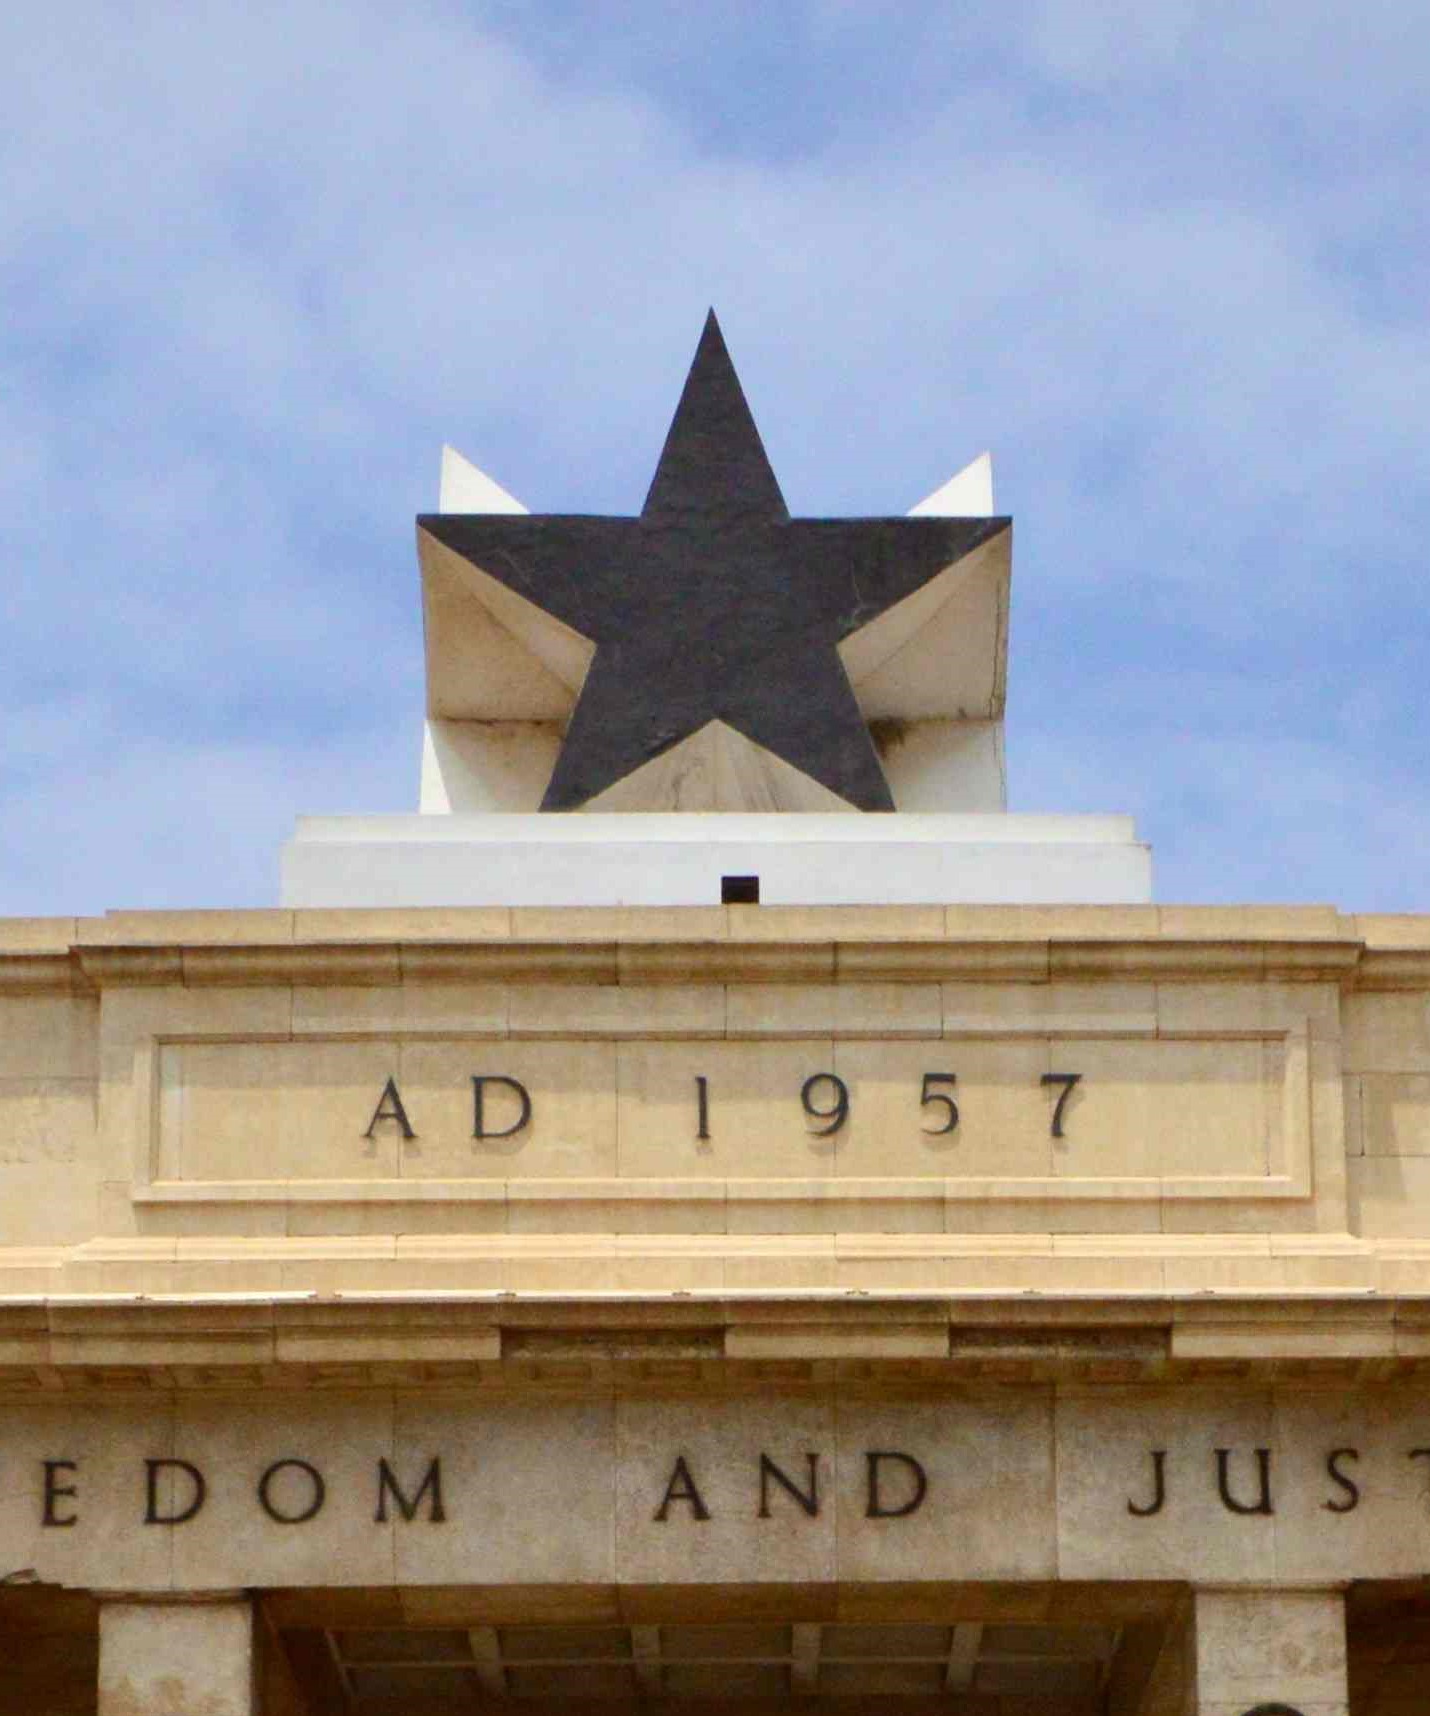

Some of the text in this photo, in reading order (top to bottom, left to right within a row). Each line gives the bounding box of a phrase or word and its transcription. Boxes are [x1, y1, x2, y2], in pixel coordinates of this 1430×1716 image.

[362, 1072, 1084, 1144] AD 1957
[652, 1451, 929, 1524] AND
